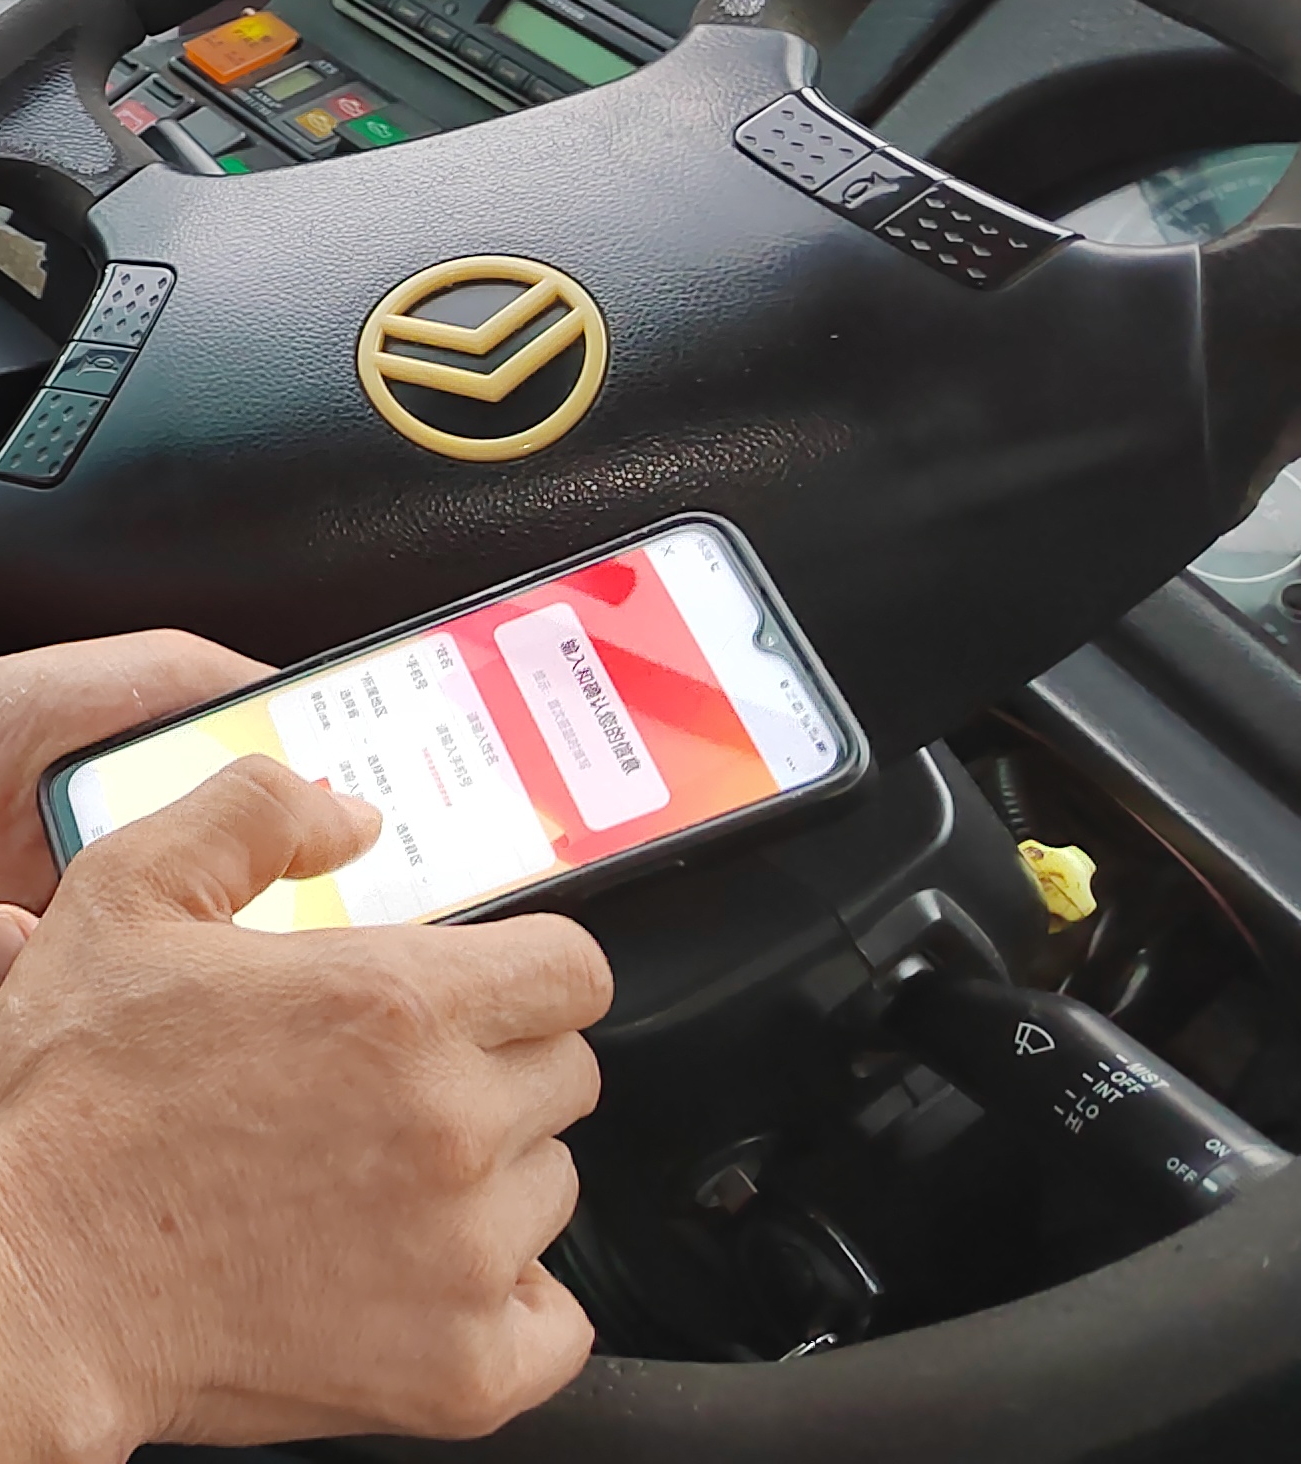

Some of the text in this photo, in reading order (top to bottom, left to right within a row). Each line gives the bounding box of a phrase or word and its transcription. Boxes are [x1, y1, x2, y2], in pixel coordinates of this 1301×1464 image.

[556, 634, 641, 776] 输入和确认您的信息
[1110, 1070, 1146, 1095] OFF
[1126, 1062, 1170, 1090] MIST
[1092, 1079, 1124, 1104] INT
[1075, 1096, 1100, 1120] LO
[1065, 1113, 1084, 1135] HI
[1204, 1138, 1232, 1158] ON
[1165, 1157, 1198, 1184] OFF
